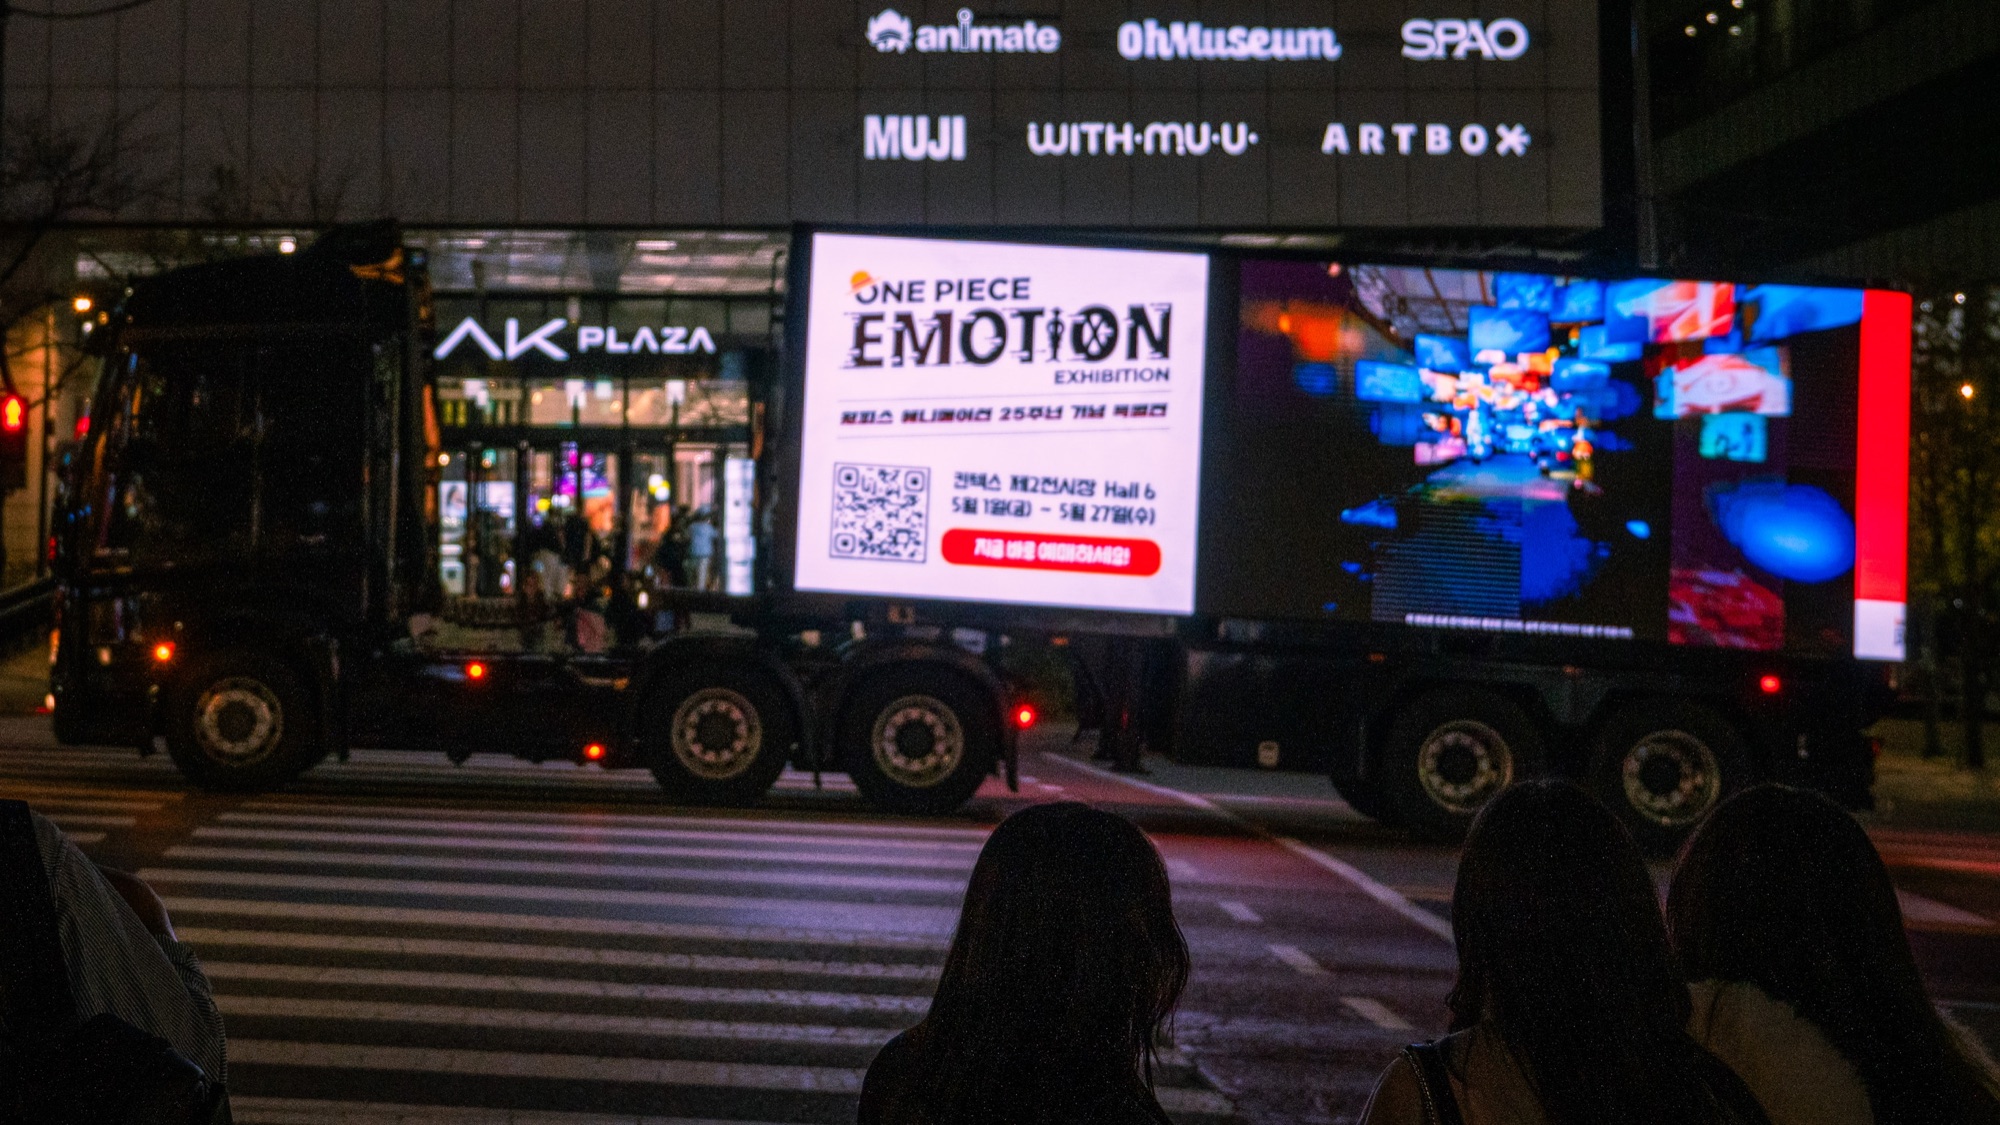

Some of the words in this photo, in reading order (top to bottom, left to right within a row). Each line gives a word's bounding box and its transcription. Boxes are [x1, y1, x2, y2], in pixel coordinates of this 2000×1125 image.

[915, 8, 1060, 53] animate
[1117, 19, 1342, 61] OhMuseum
[1400, 18, 1530, 60] SPAO
[864, 115, 966, 161] MUJI
[1321, 122, 1531, 156] ARTBOX
[855, 280, 926, 304] ONE
[935, 277, 1031, 302] PIECE
[433, 316, 570, 361] AK
[577, 326, 717, 354] PLAZA
[1053, 367, 1171, 385] EXHIBITION
[952, 497, 978, 515] 5월
[1060, 503, 1085, 522] 5월
[1105, 481, 1139, 499] Hall
[1144, 483, 1156, 500] 6
